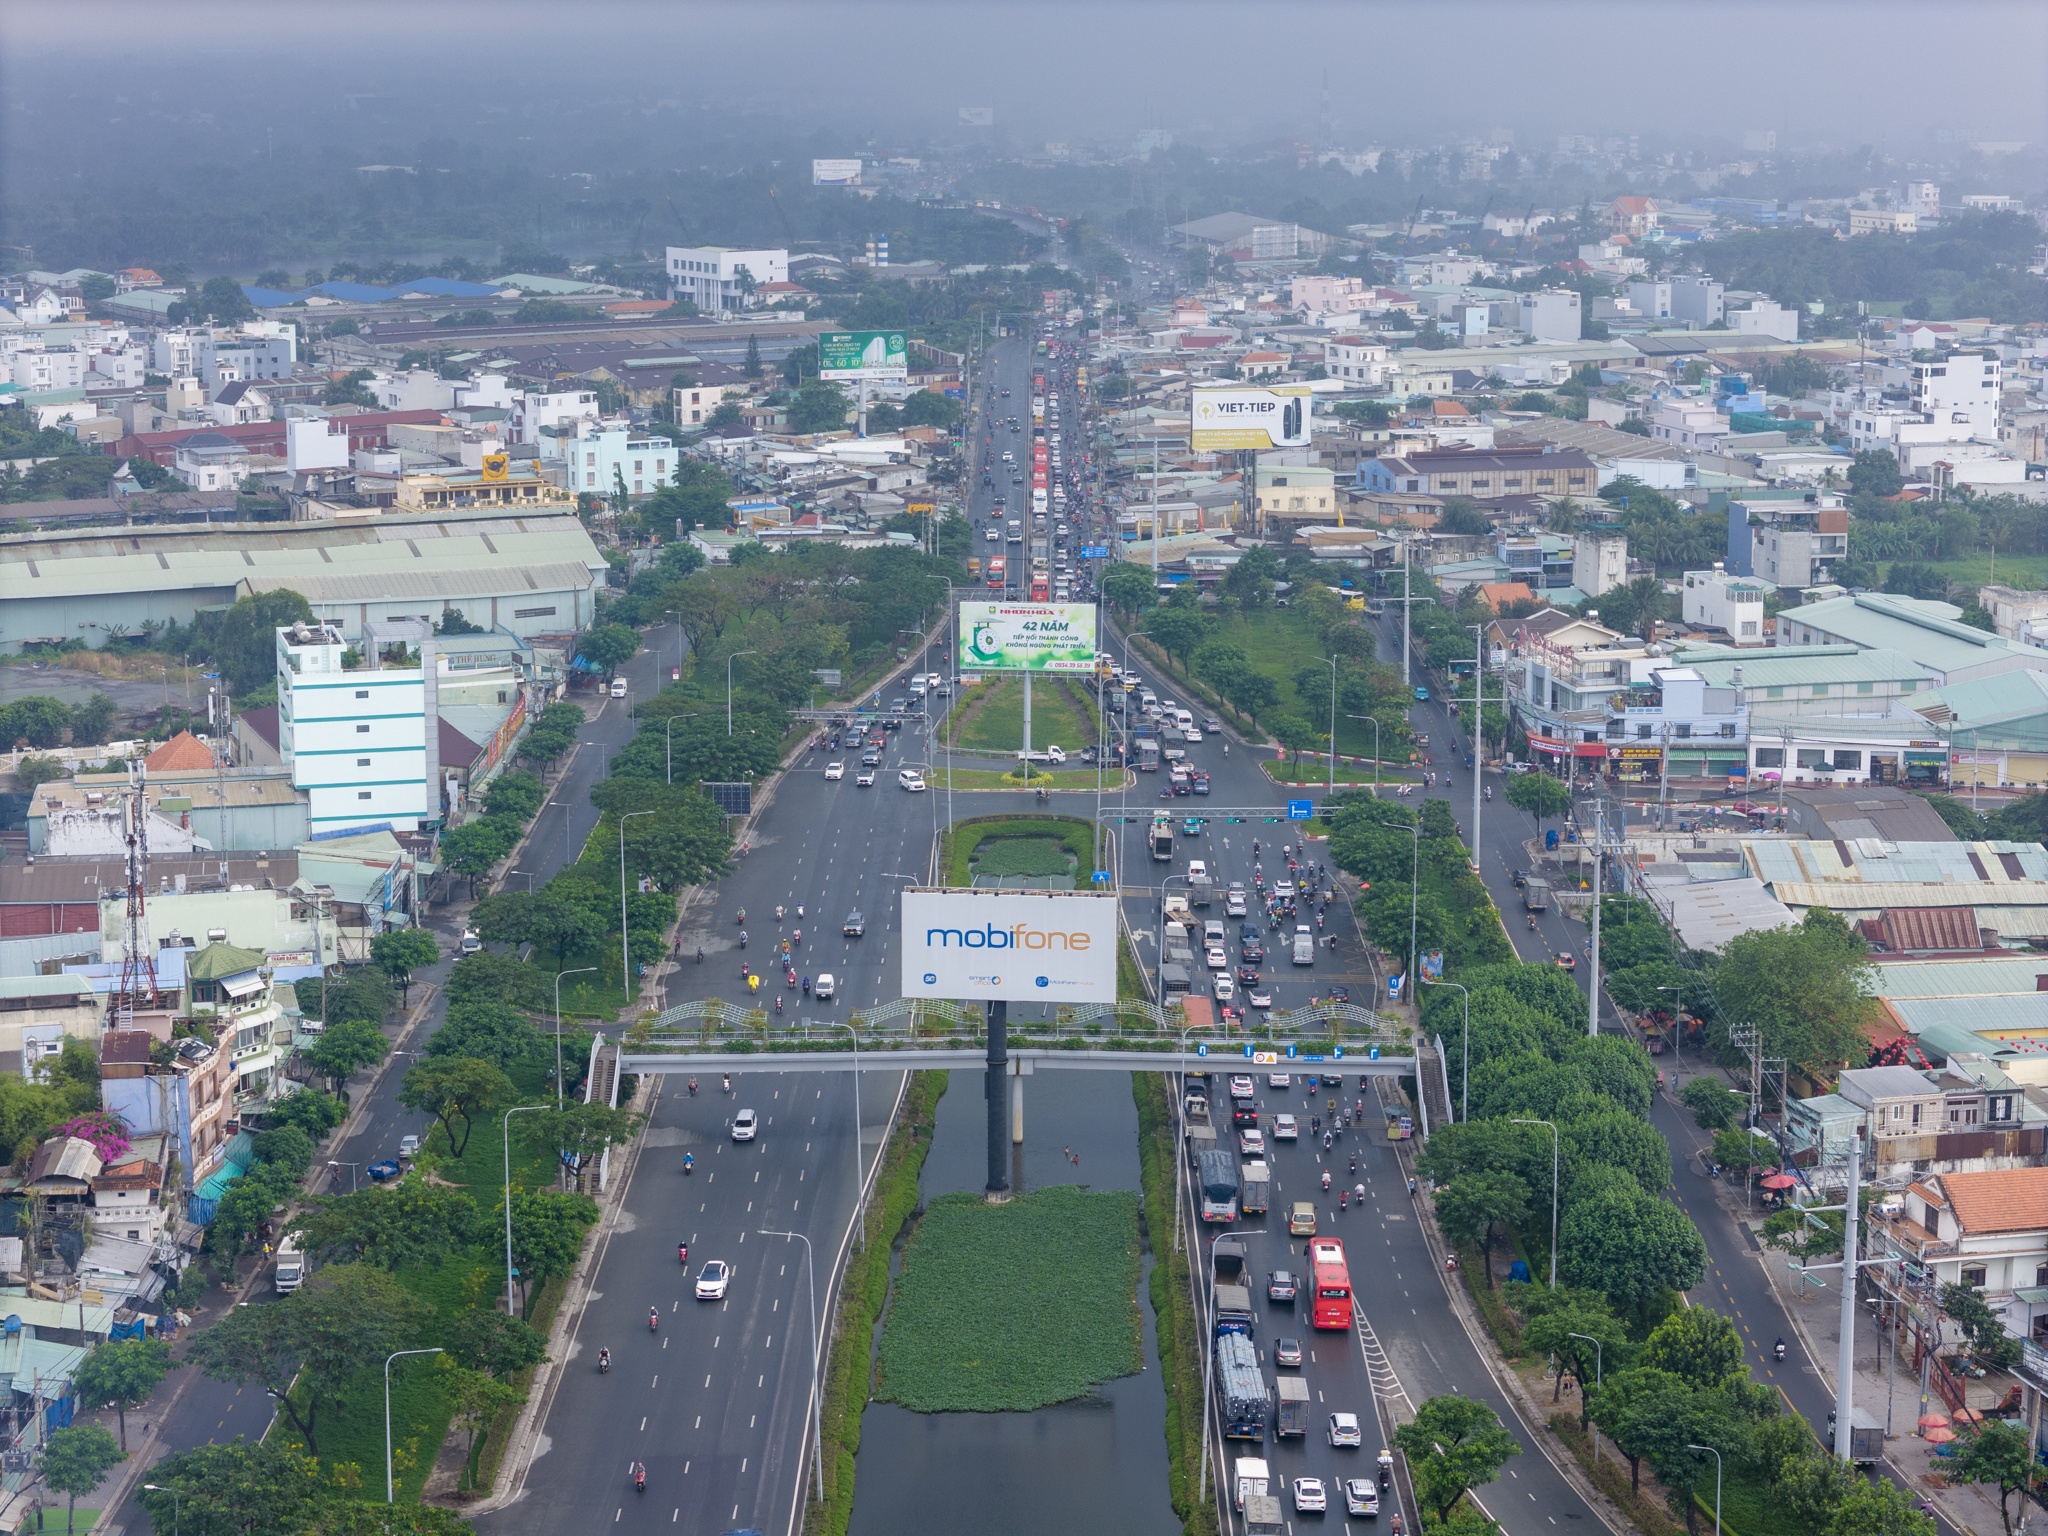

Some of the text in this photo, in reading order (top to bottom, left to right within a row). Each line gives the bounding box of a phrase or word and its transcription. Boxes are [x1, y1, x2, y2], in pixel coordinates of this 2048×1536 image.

[1218, 402, 1276, 413] VIET-TIEP
[1022, 620, 1069, 631] 42 NĂM
[927, 923, 1091, 951] mobifone
